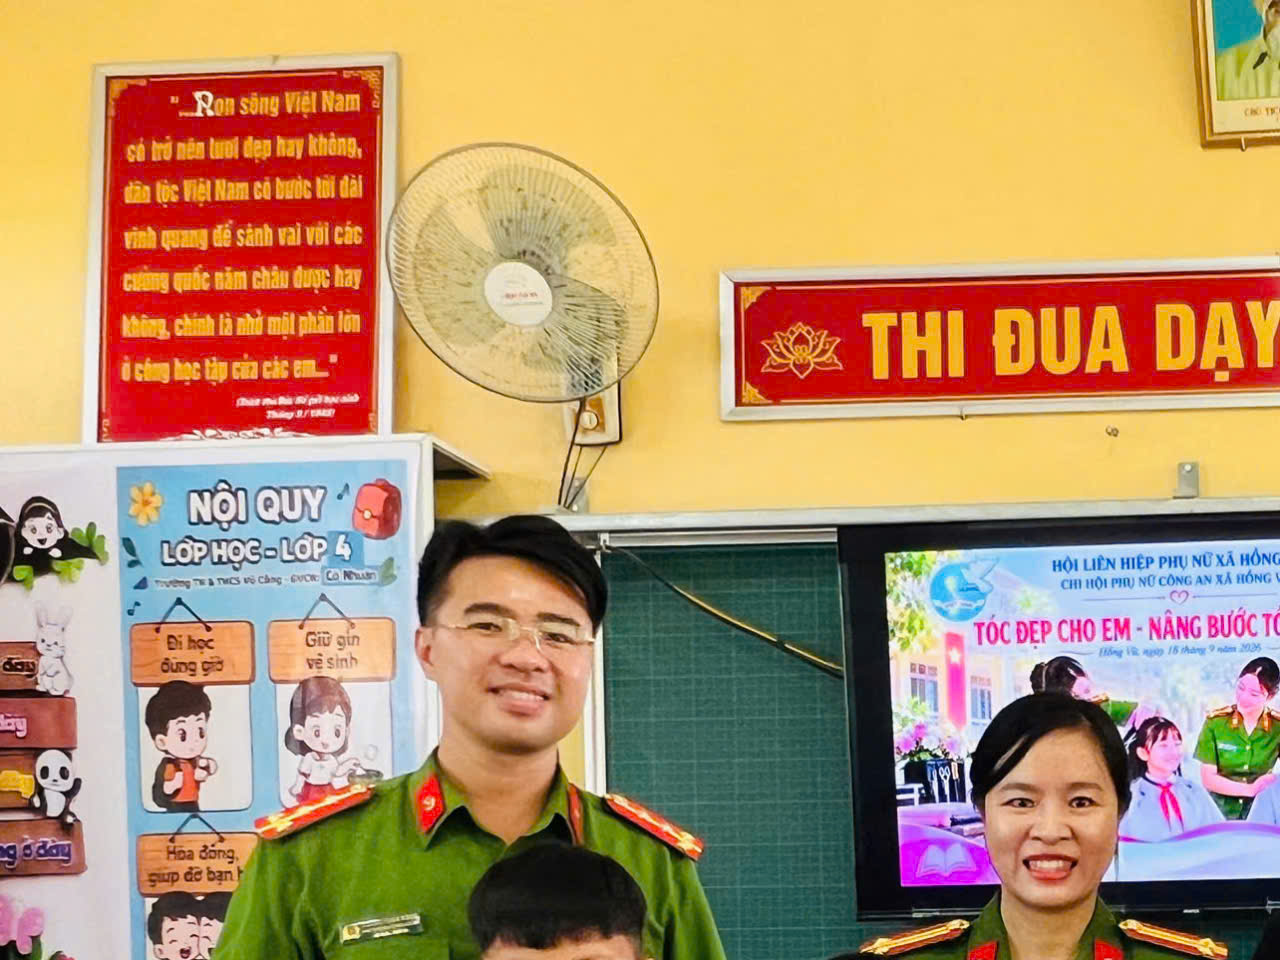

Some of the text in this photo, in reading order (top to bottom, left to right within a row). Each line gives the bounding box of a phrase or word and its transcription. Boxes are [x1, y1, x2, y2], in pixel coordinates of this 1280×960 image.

[285, 91, 317, 119] Việt
[321, 90, 361, 113] Nam
[243, 136, 272, 163] đẹp
[276, 136, 305, 159] hay
[214, 178, 250, 201] Nam
[278, 223, 301, 246] vai
[334, 264, 363, 289] hay
[861, 309, 965, 380] THI
[992, 305, 1130, 377] ĐUA
[188, 480, 328, 530] NỘI QUY
[210, 537, 260, 571] HỌC
[334, 534, 352, 561] 4
[1052, 555, 1079, 574] HỘI
[1083, 554, 1116, 572] LIÊN
[1121, 553, 1154, 574] HIỆP
[1158, 554, 1188, 572] PHỤ
[1215, 550, 1236, 567] XÃ
[1061, 577, 1083, 590] CHI
[1087, 575, 1109, 591] HỘI
[1111, 576, 1135, 590] PHỤ
[1158, 573, 1193, 587] CÔNG
[1195, 573, 1213, 585] AN
[1215, 571, 1233, 586] XÃ
[974, 614, 1012, 646] TÓC
[1016, 619, 1052, 650] ĐẸP
[1057, 617, 1096, 643] CHO
[1102, 616, 1132, 642] EM
[1149, 609, 1201, 641] NÂNG
[1207, 607, 1257, 638] BƯỚC
[166, 634, 215, 655] Đi học
[326, 654, 358, 670] sinh
[207, 866, 233, 885] bạn
